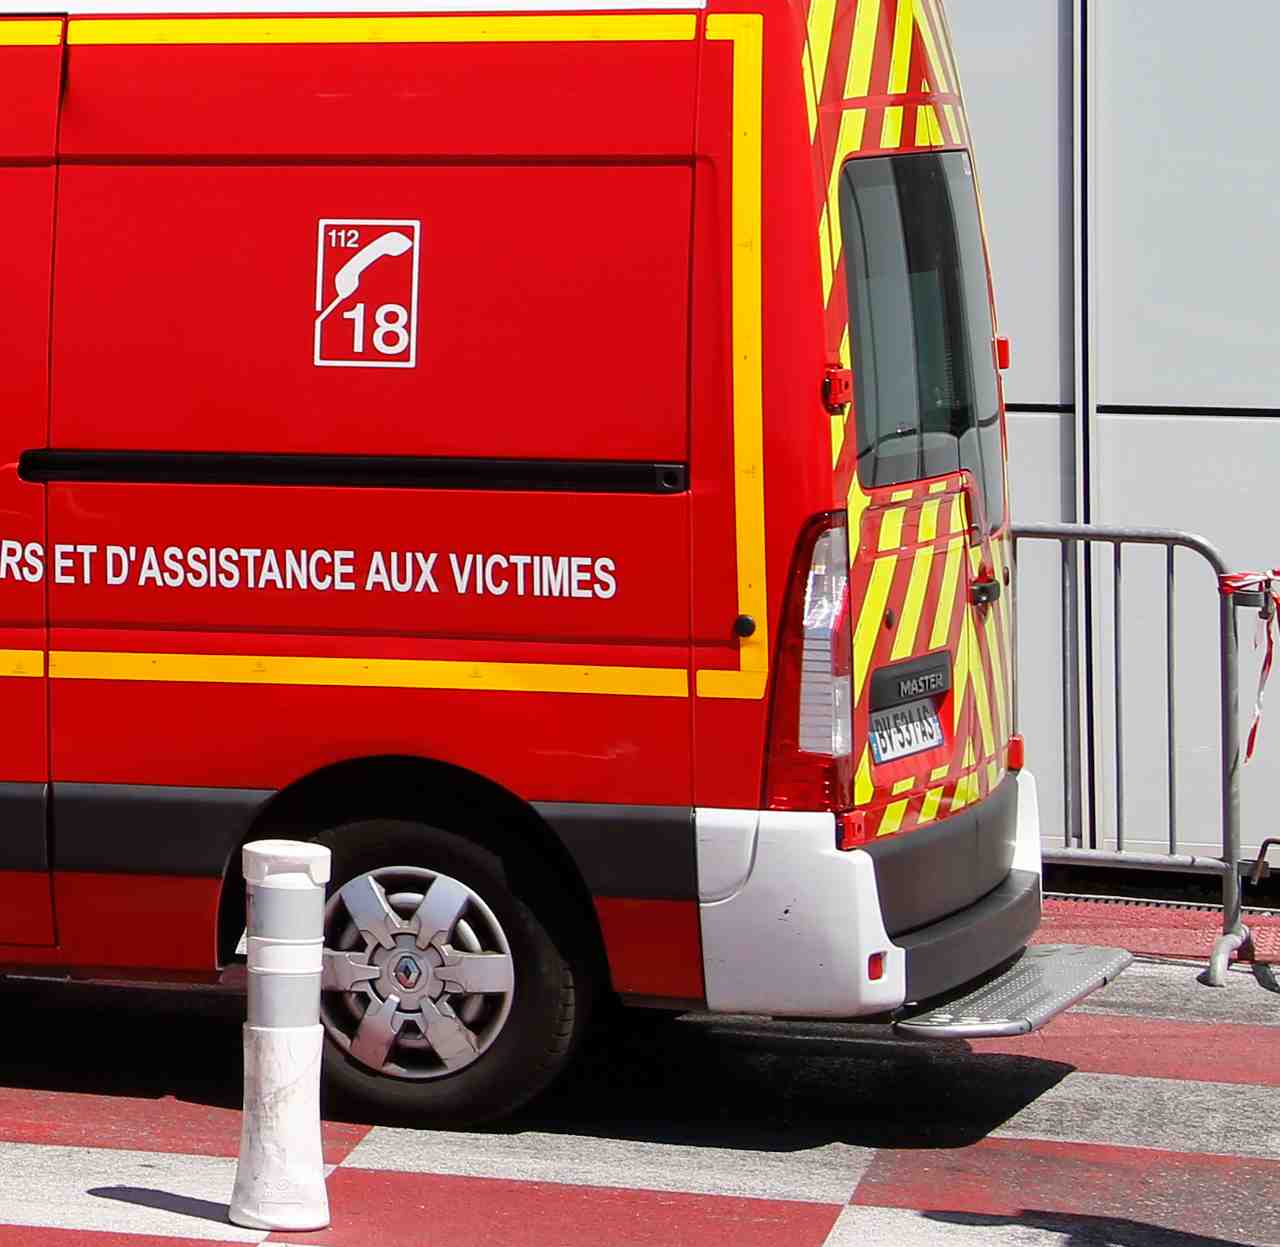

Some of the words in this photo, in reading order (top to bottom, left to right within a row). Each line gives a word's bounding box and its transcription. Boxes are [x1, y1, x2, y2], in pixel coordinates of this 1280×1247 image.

[328, 229, 360, 248] 112
[343, 303, 410, 355] 18
[54, 544, 98, 585] ET
[106, 545, 356, 591] D'ASSISTANCE
[364, 551, 439, 593] AUX
[449, 553, 617, 599] VICTIMES
[900, 673, 944, 698] MASTER
